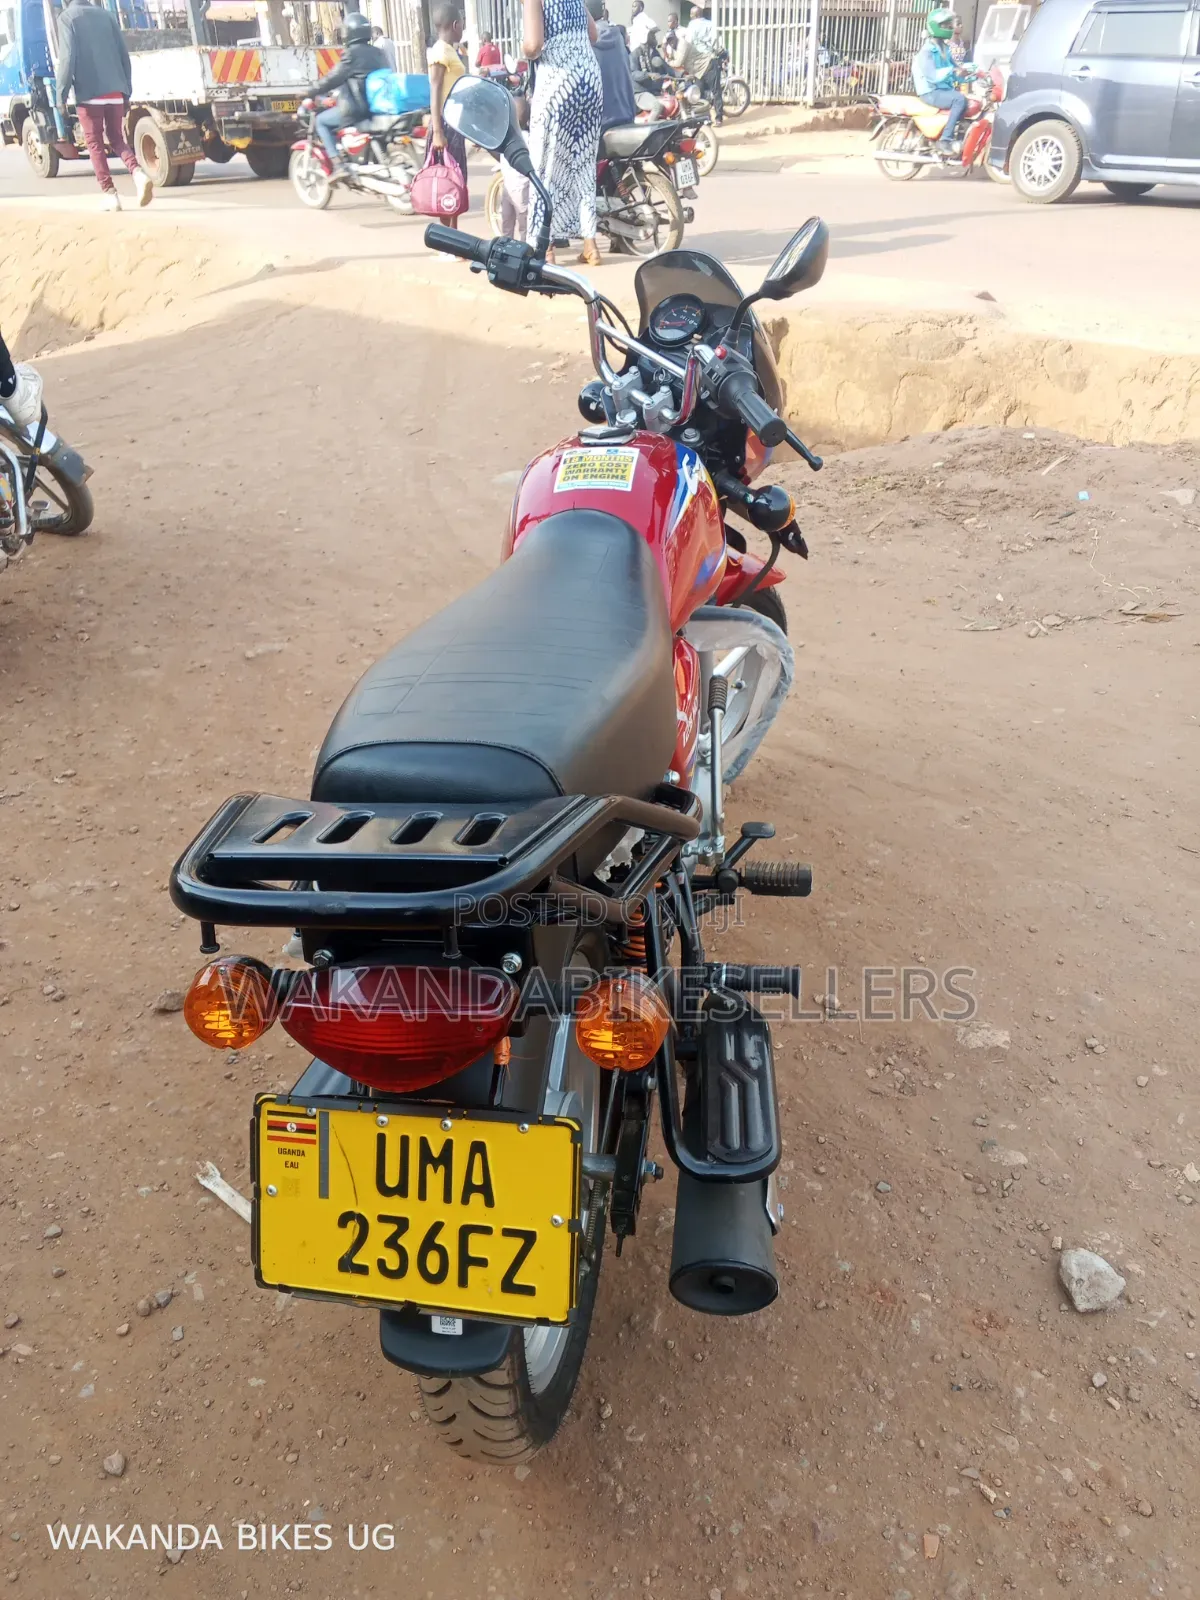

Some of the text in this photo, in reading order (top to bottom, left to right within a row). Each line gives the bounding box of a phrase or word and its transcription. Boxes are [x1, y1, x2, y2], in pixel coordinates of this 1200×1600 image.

[584, 455, 632, 463] MONTHS
[277, 1147, 306, 1157] UGANDA
[284, 1160, 299, 1169] EAU
[376, 1132, 495, 1208] UMA
[337, 1210, 537, 1297] 236FZ
